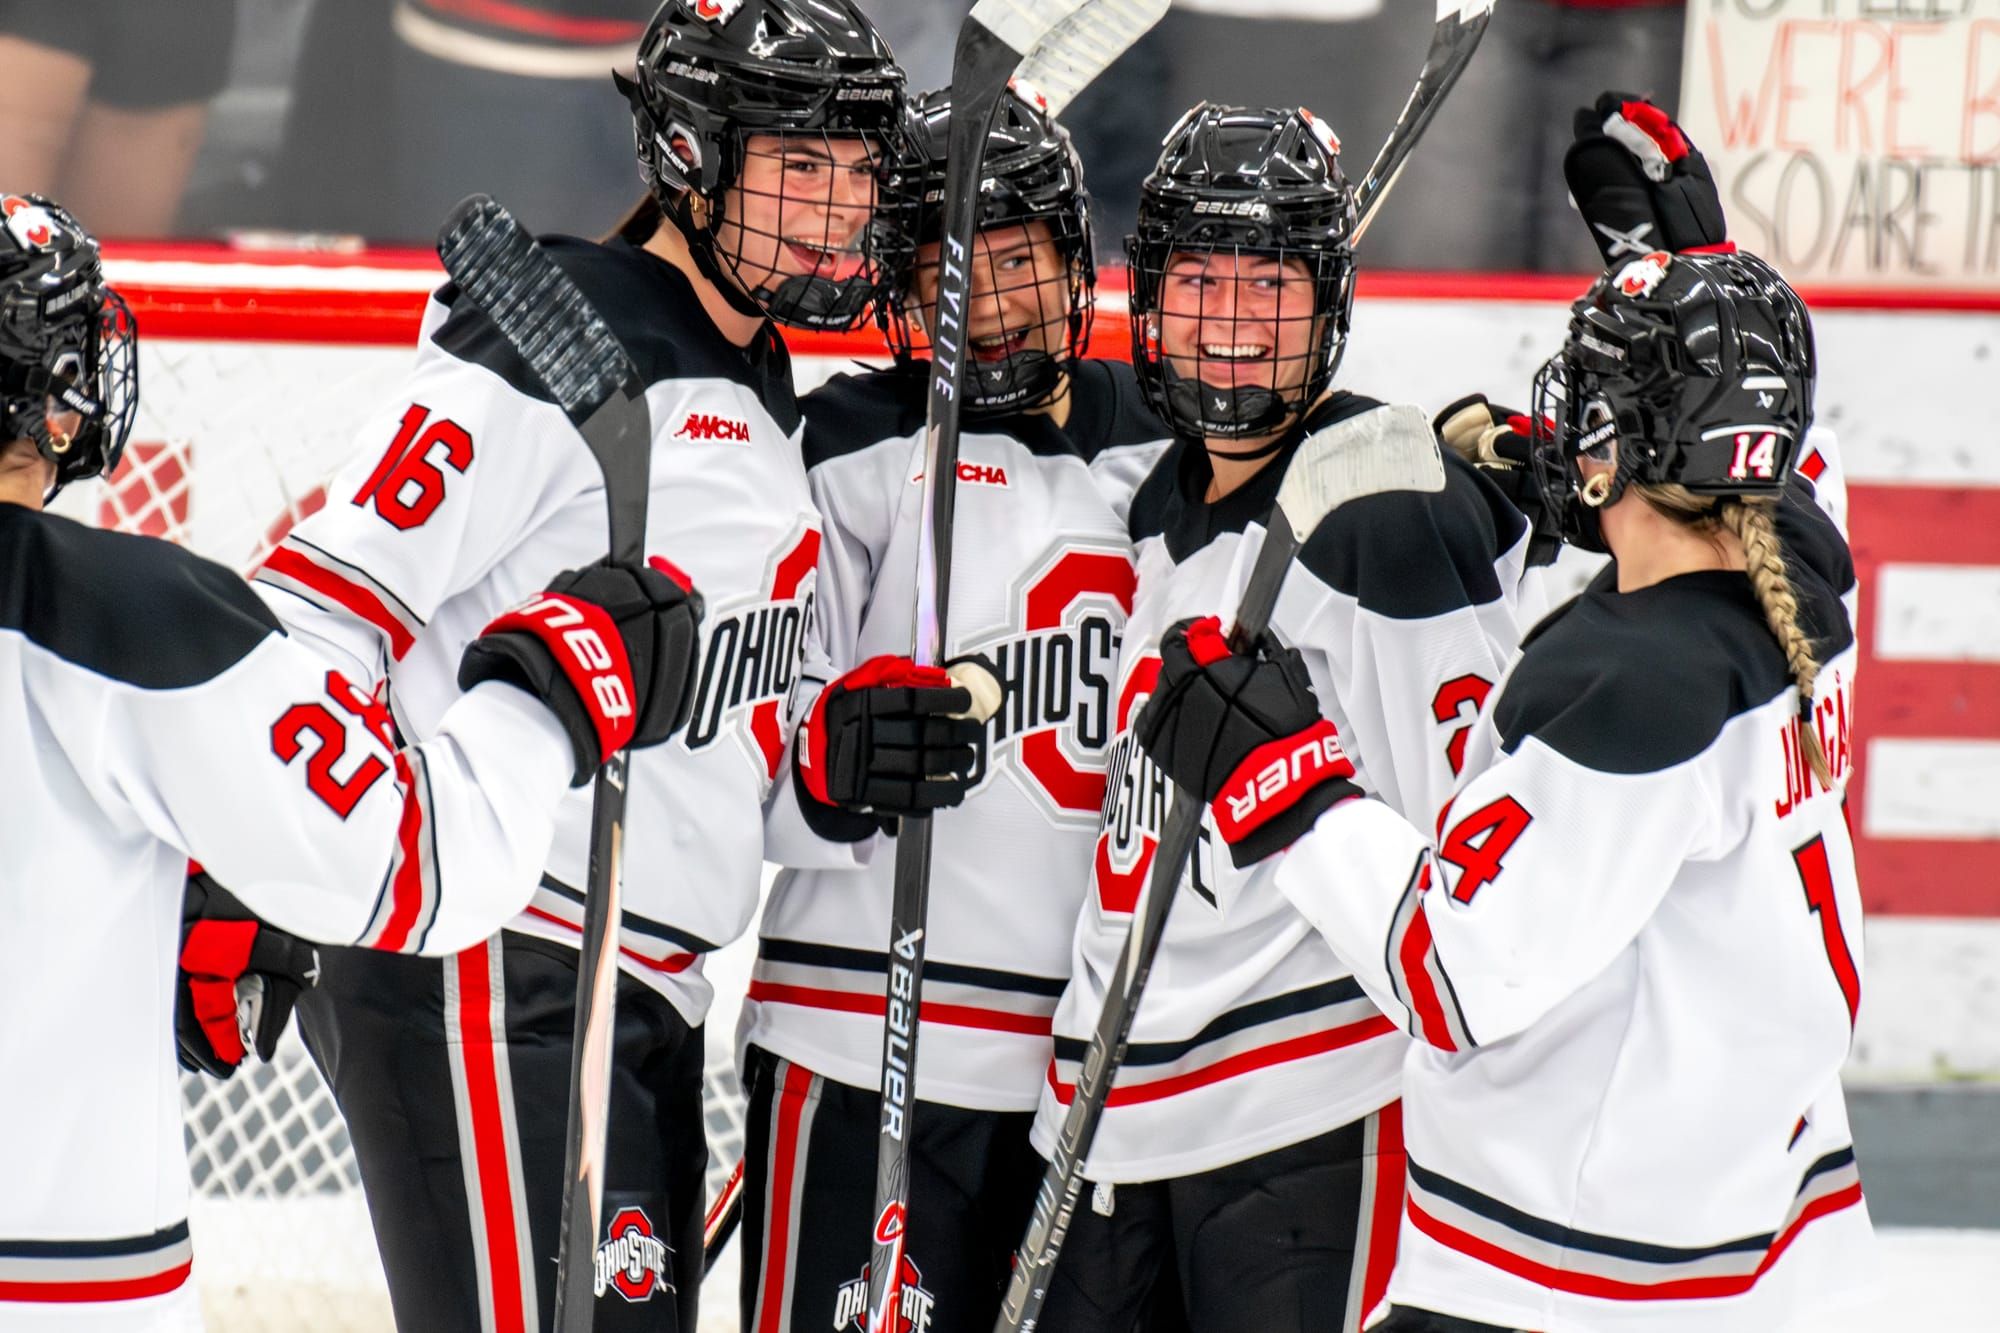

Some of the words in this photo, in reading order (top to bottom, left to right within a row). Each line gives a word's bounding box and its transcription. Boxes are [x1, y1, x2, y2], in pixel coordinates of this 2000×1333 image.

[666, 61, 719, 85] BAUER
[836, 88, 894, 100] BAUER
[655, 132, 689, 175] BAUER
[1193, 201, 1269, 220] BAUER
[936, 231, 964, 402] FLYLITE
[697, 414, 750, 442] WCHA
[352, 402, 475, 531] 16
[957, 461, 1007, 485] CHA
[1728, 432, 1777, 480] 14
[517, 593, 632, 719] BAU
[1226, 735, 1345, 823] AUER
[882, 962, 914, 1142] BAUER
